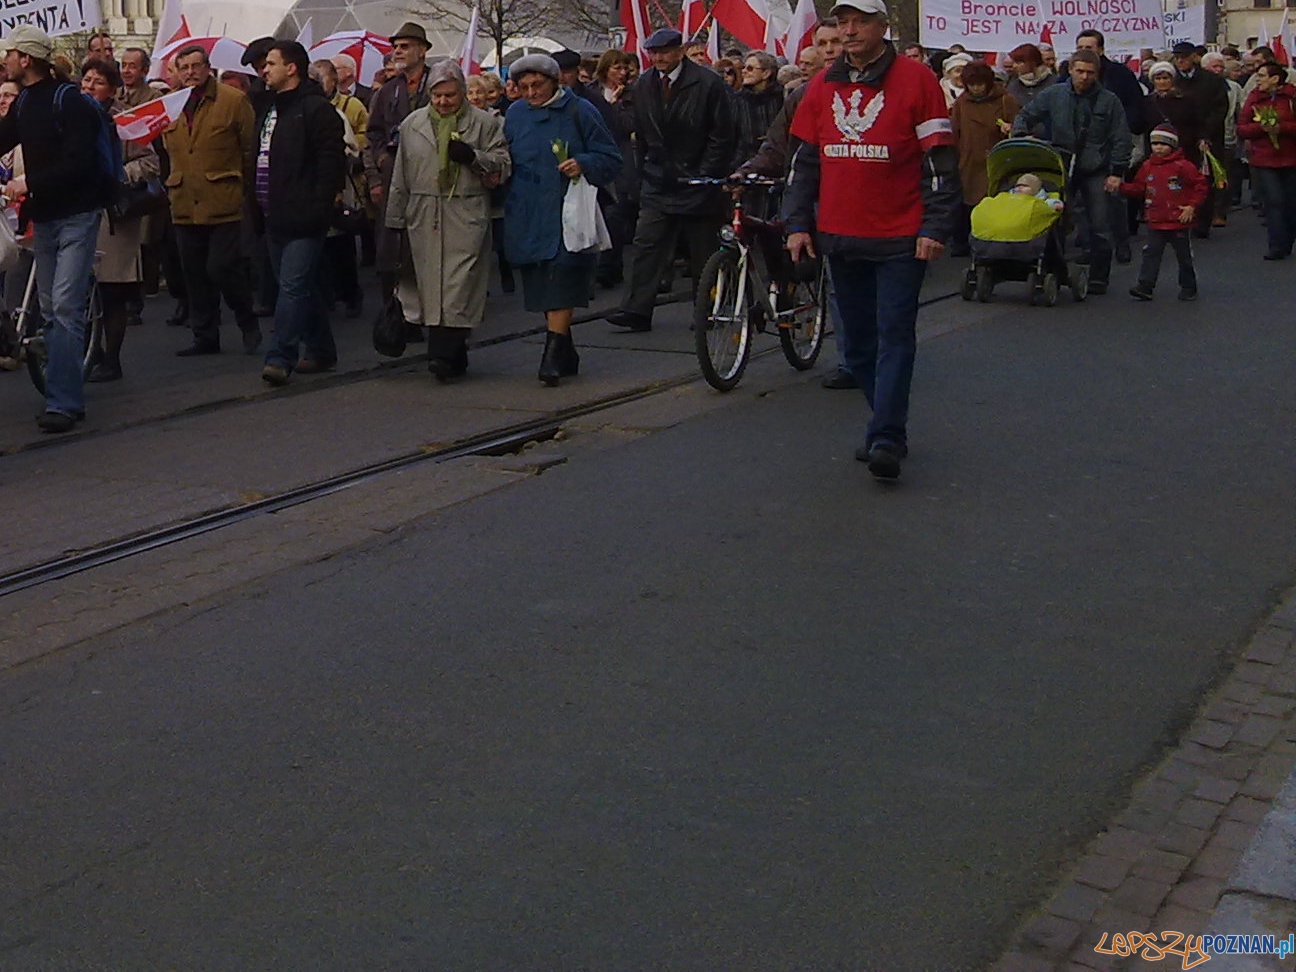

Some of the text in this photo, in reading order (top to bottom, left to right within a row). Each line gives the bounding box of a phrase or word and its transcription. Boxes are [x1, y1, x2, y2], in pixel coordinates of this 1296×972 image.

[927, 15, 947, 31] TO
[961, 18, 1002, 36] JEST
[850, 144, 889, 159] POLSKA
